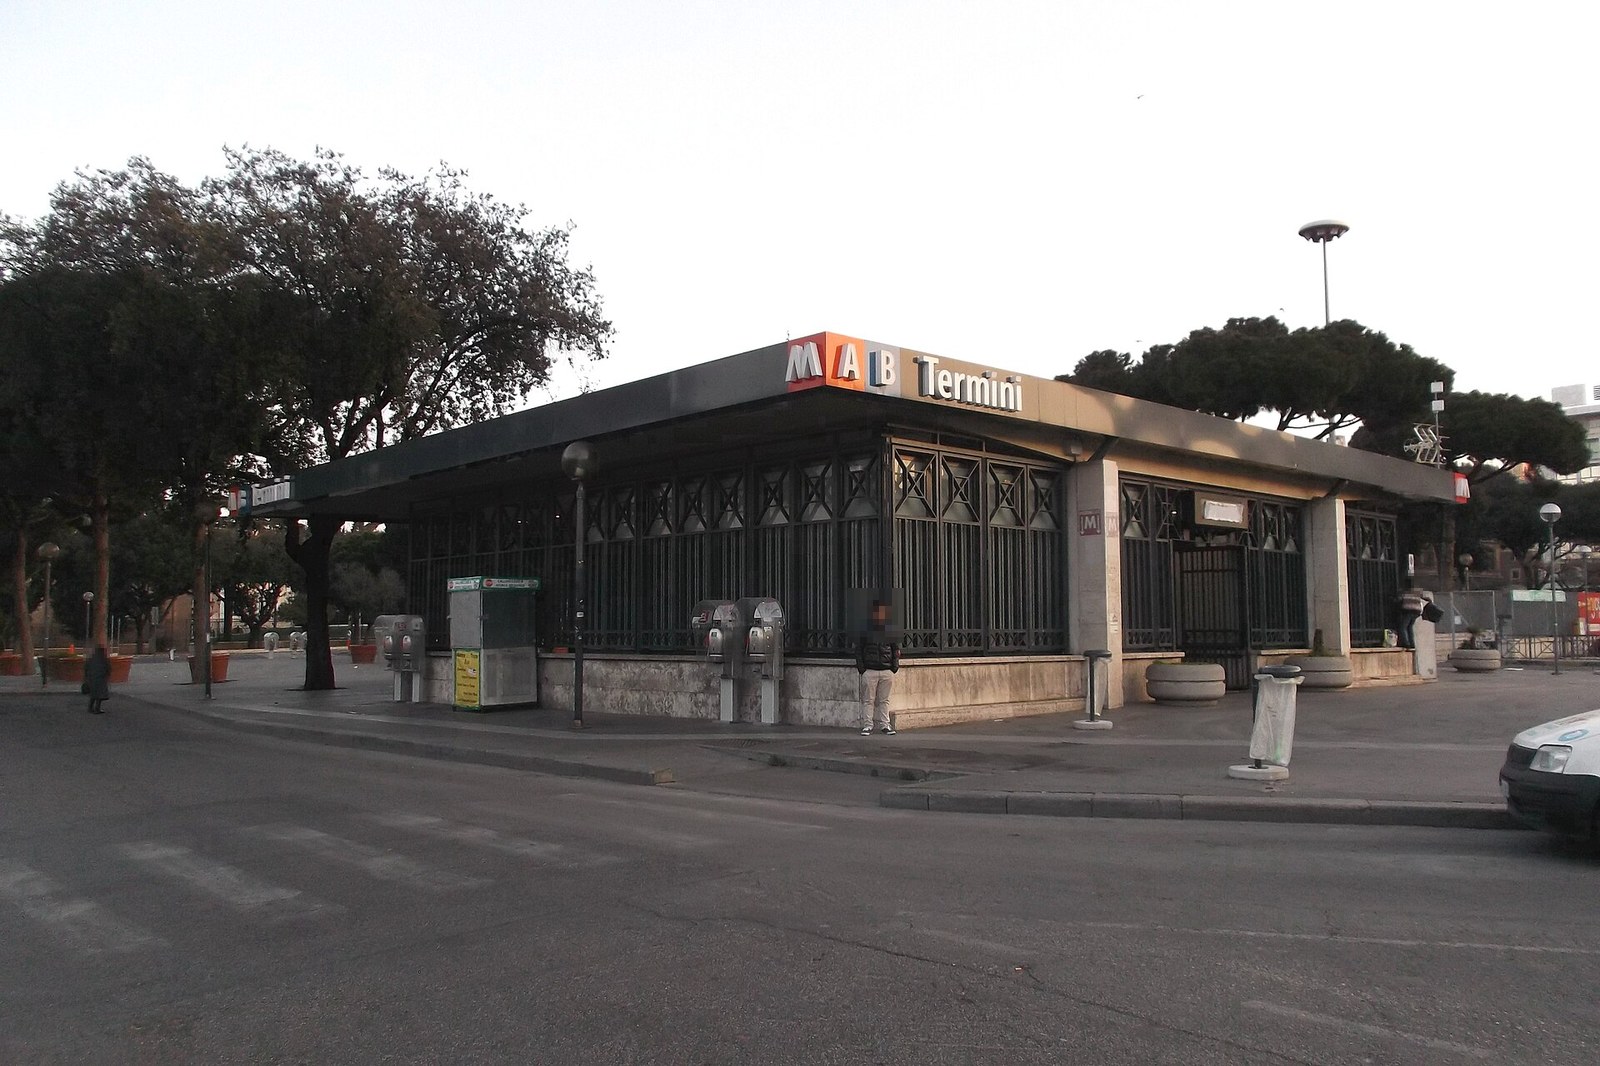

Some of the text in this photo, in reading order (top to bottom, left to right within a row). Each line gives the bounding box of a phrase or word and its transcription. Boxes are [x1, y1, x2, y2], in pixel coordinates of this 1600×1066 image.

[785, 341, 1023, 412] M A B Termini
[1084, 515, 1096, 529] M
